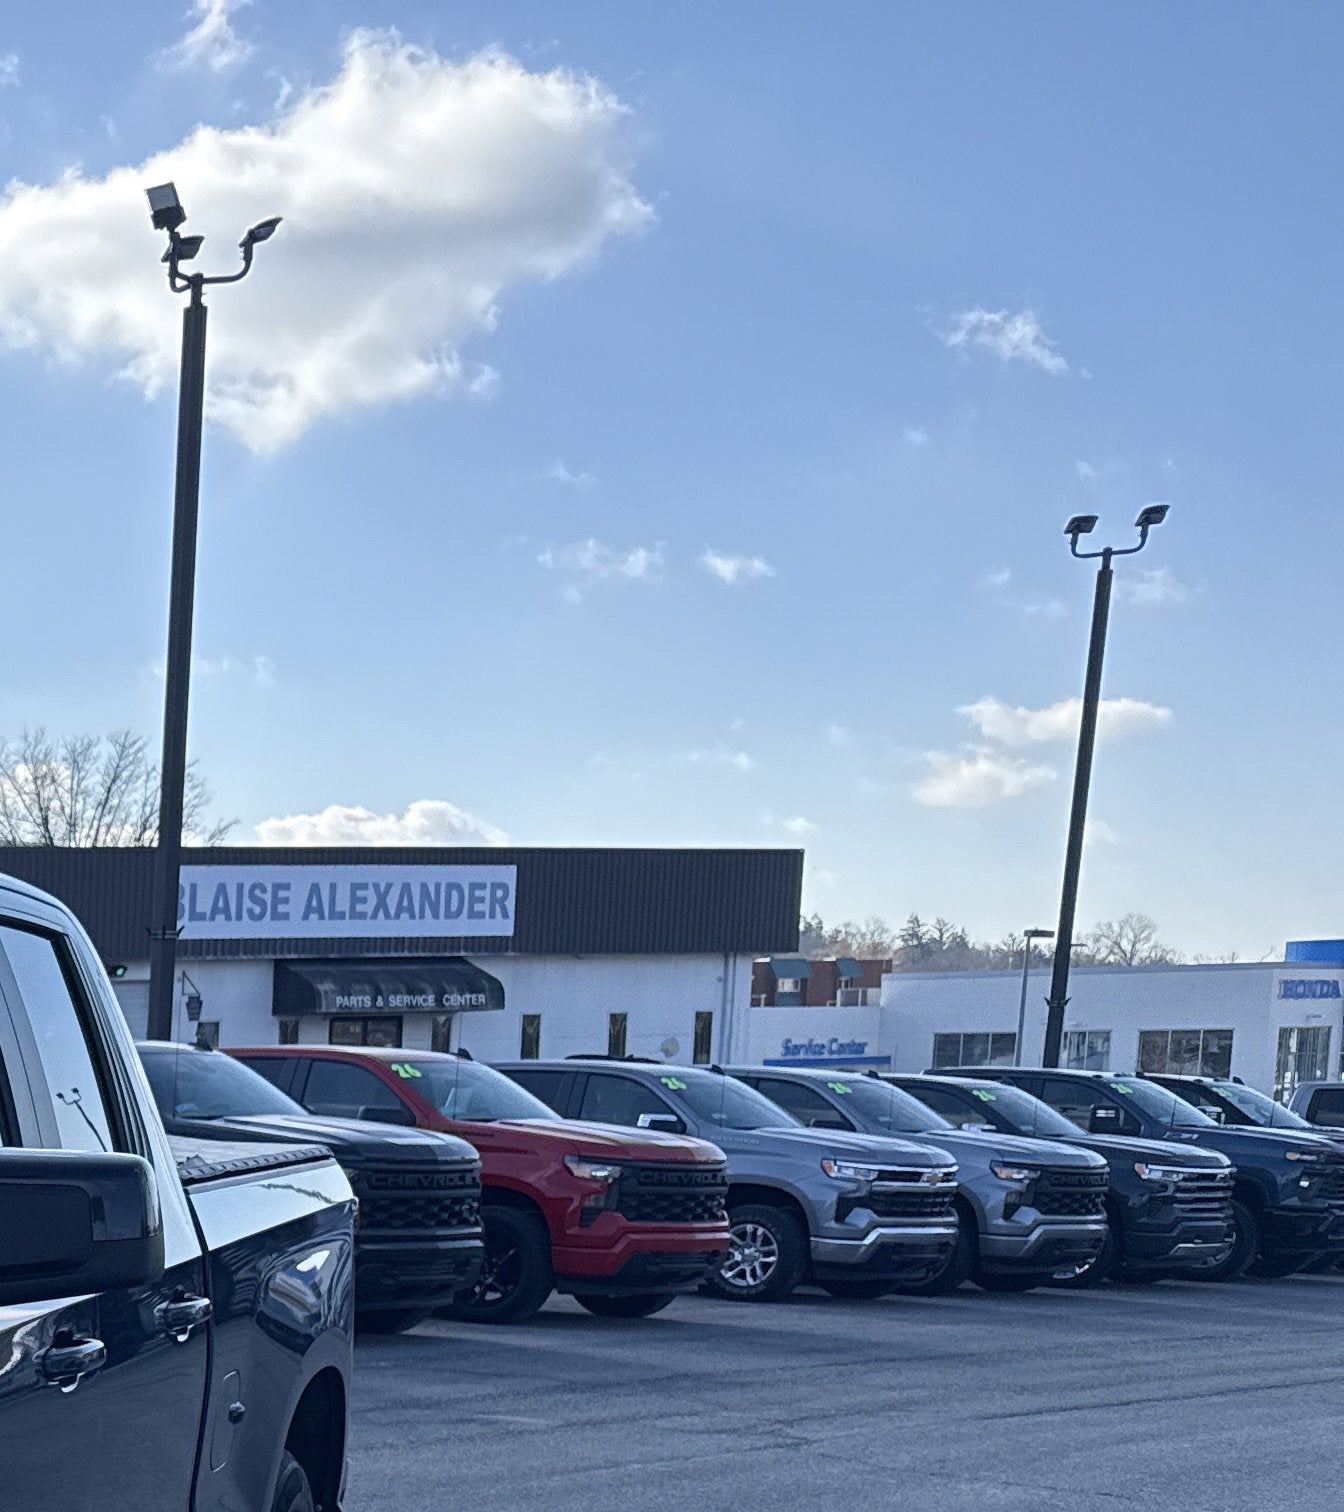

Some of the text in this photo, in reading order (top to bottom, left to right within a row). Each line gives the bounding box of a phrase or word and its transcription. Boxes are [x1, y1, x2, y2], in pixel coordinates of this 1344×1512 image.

[302, 881, 510, 920] ALEXANDER
[1278, 980, 1342, 999] HONDA
[336, 993, 486, 1008] PARTS & SERVICE CENTER
[781, 1038, 868, 1056] Service Center
[391, 1063, 423, 1079] 26
[660, 1077, 688, 1090] 26
